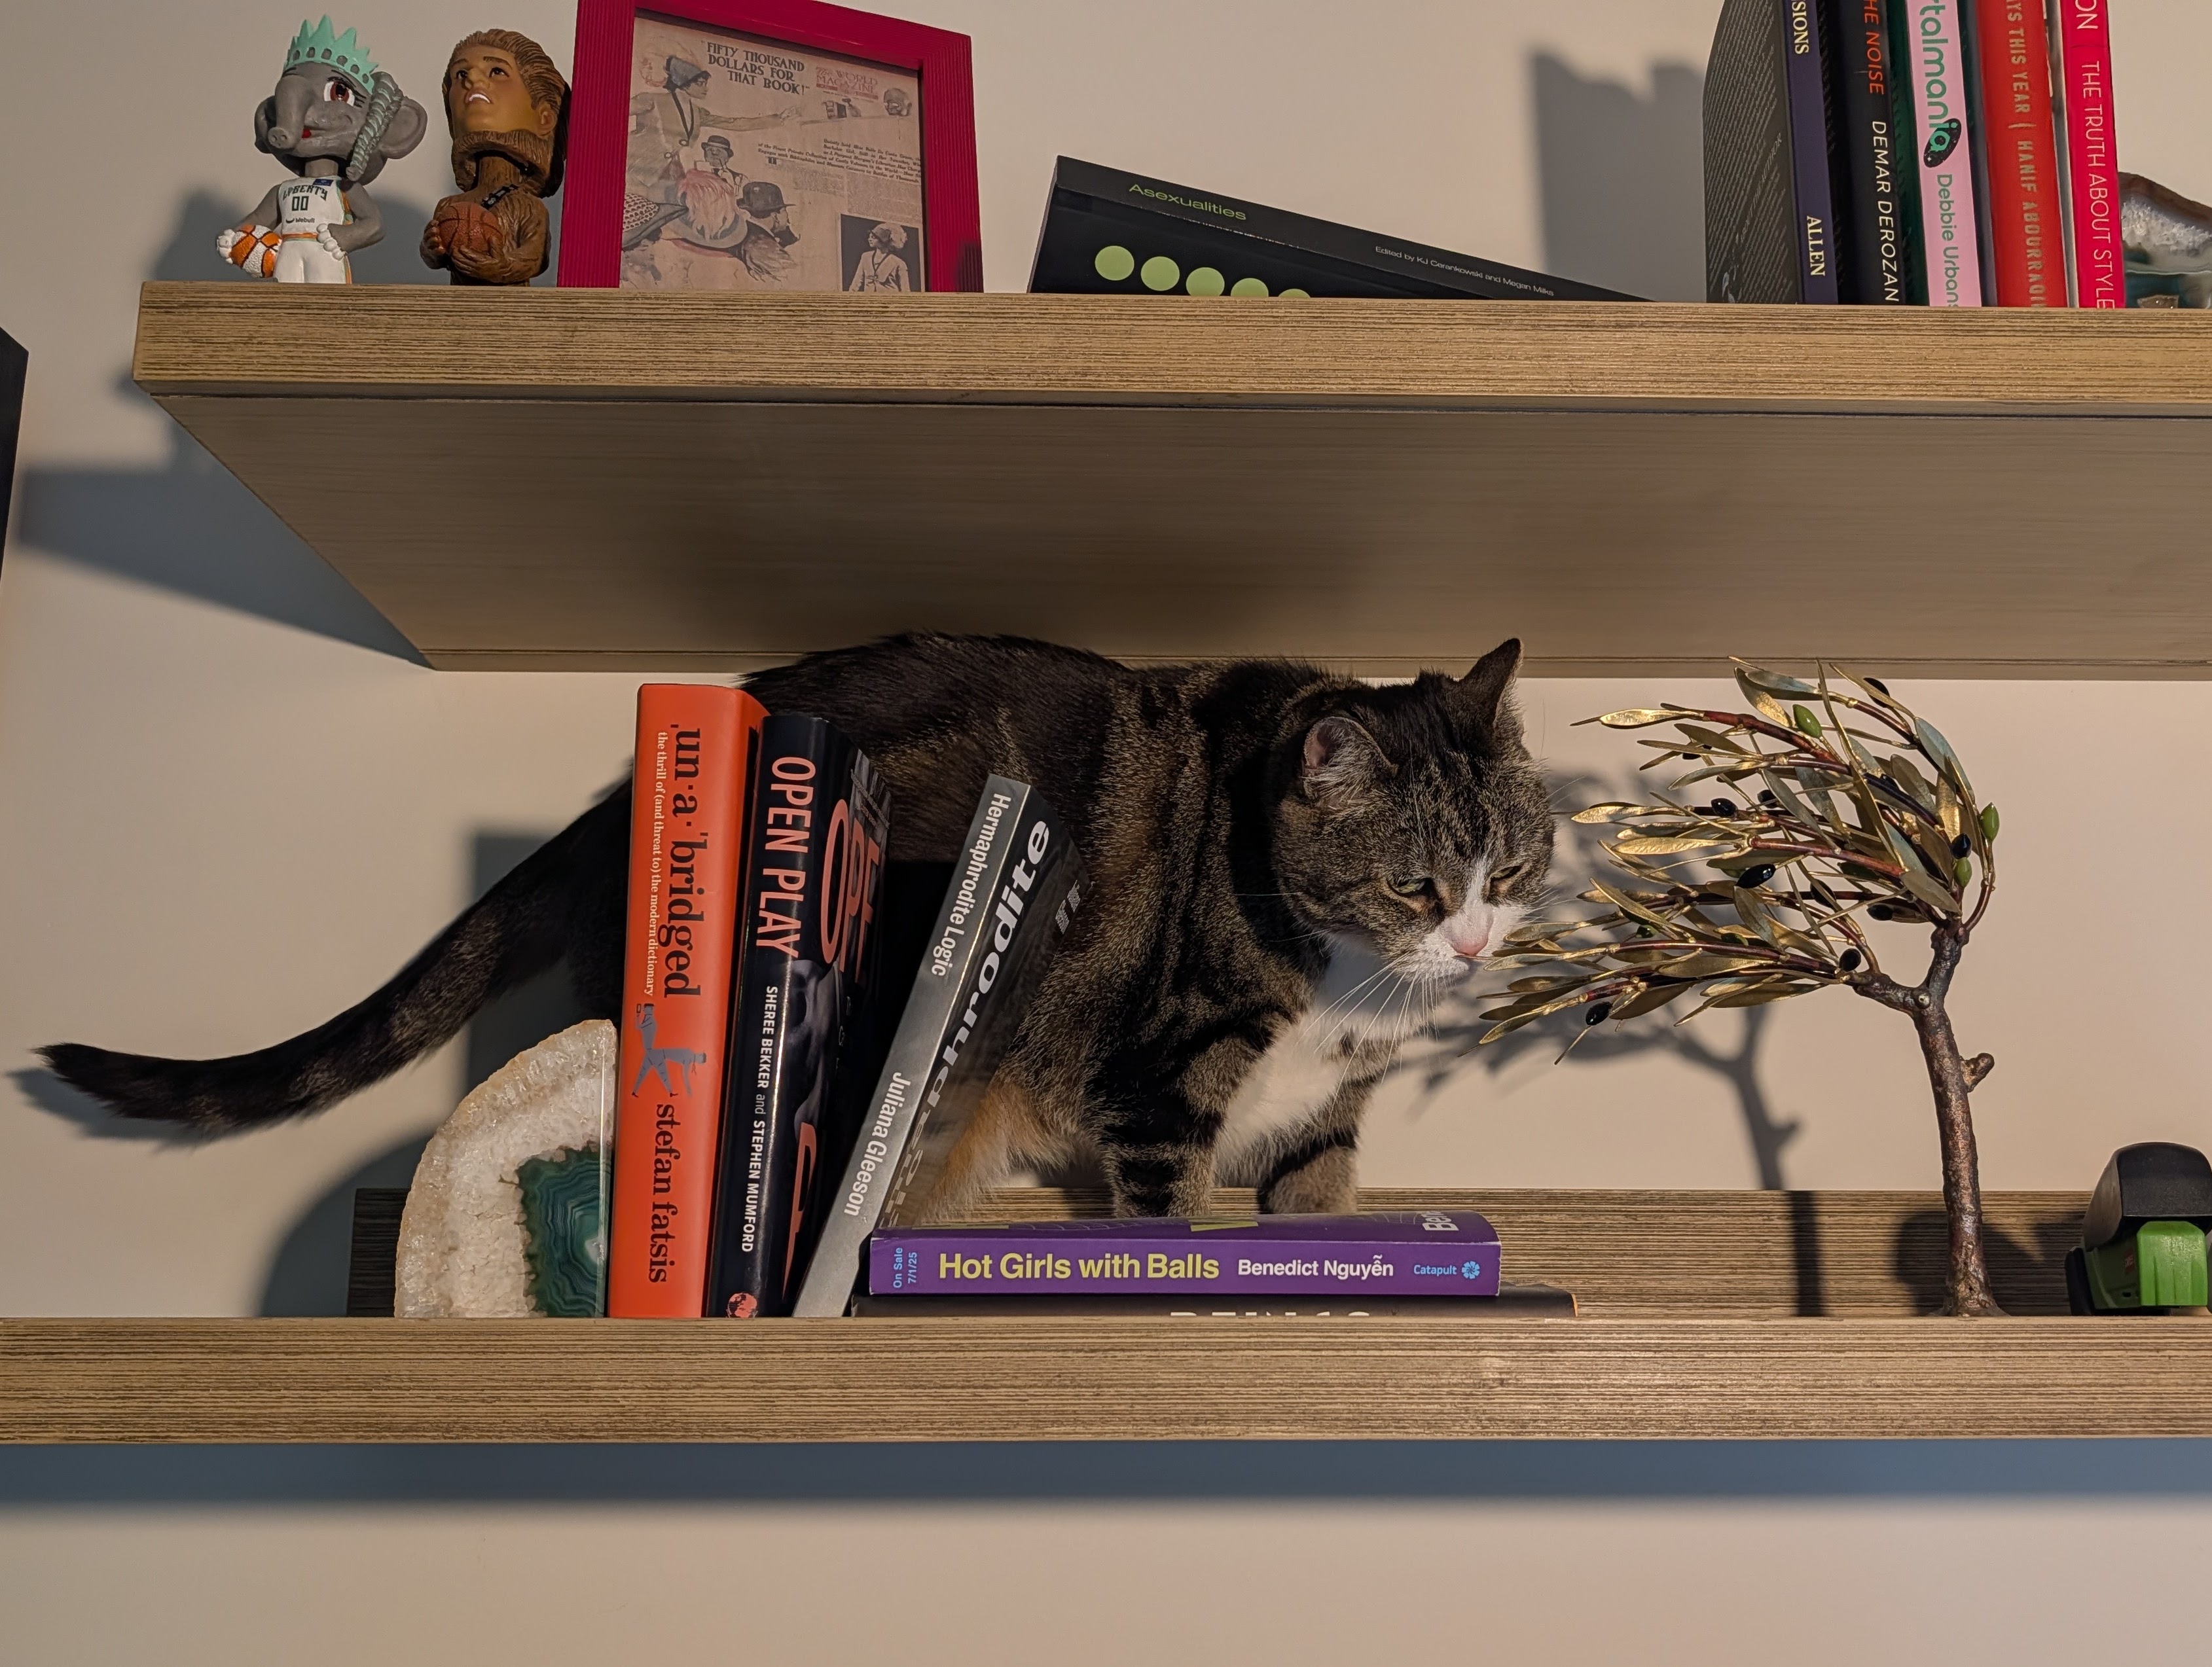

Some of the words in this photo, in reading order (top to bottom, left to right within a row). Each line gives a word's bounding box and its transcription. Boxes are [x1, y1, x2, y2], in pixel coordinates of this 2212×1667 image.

[1792, 0, 1809, 54] SIONS
[1864, 0, 1879, 25] HE
[2006, 0, 2023, 22] YS
[2075, 0, 2099, 30] ON
[744, 50, 805, 71] THOUSAND
[1866, 31, 1885, 95] NOISE
[2008, 27, 2027, 65] THIS
[708, 54, 765, 75] DOLLARS
[771, 67, 795, 82] FOR
[727, 70, 757, 86] THAT
[836, 70, 877, 84] WORLD
[1919, 0, 1959, 151] talmania
[2081, 60, 2101, 99] THE
[2012, 71, 2030, 114] YEAR
[2084, 104, 2106, 166] TRUTH
[1872, 121, 1891, 193] DEMAR
[2018, 140, 2039, 192] HANIF
[292, 196, 310, 211] 00
[1129, 184, 1246, 221] Asexualities
[1936, 174, 1957, 242] Debbie
[2088, 173, 2111, 243] ABOUT
[1807, 215, 1825, 277] ALLEN
[1877, 200, 1899, 302] DEROZAN
[1375, 246, 1402, 259] Edited
[1404, 253, 1415, 262] by
[1417, 257, 1428, 265] KJ
[1430, 260, 1483, 279] Cerankowski
[1485, 274, 1500, 283] and
[1503, 278, 1531, 291] Megan
[1533, 285, 1554, 296] Milks
[1942, 246, 1959, 307] Urban
[2094, 249, 2115, 308] STYLE
[657, 732, 668, 749] the
[655, 781, 666, 793] of
[656, 751, 668, 780] thrill
[653, 795, 664, 819] (and
[765, 756, 816, 853] OPEN
[653, 822, 664, 855] threat
[949, 793, 1012, 925] Hermaphrodite
[650, 857, 662, 873] to)
[651, 874, 662, 892] the
[648, 894, 660, 937] modern
[755, 868, 806, 958] PLAY
[644, 938, 659, 996] dictionary
[931, 925, 965, 977] Logic
[762, 986, 778, 1035] SHEREE
[757, 1038, 773, 1088] BEKKER
[754, 1094, 767, 1115] and
[872, 1071, 911, 1138] Juliana
[653, 1103, 681, 1196] stefan
[748, 1120, 766, 1179] STEPHEN
[844, 1139, 887, 1217] Gleeson
[741, 1183, 759, 1253] MUMFORD
[648, 1200, 679, 1283] fatsis
[894, 1247, 903, 1270] Sale
[893, 1273, 903, 1289] On
[908, 1251, 918, 1284] 7/1/25
[939, 1252, 992, 1280] Hot
[1000, 1252, 1072, 1280] Girls
[1078, 1252, 1140, 1280] with
[1147, 1253, 1220, 1280] Balls
[1237, 1259, 1318, 1276] Benedict
[1324, 1254, 1394, 1280] Nguyễn
[1413, 1264, 1457, 1277] Catapult
